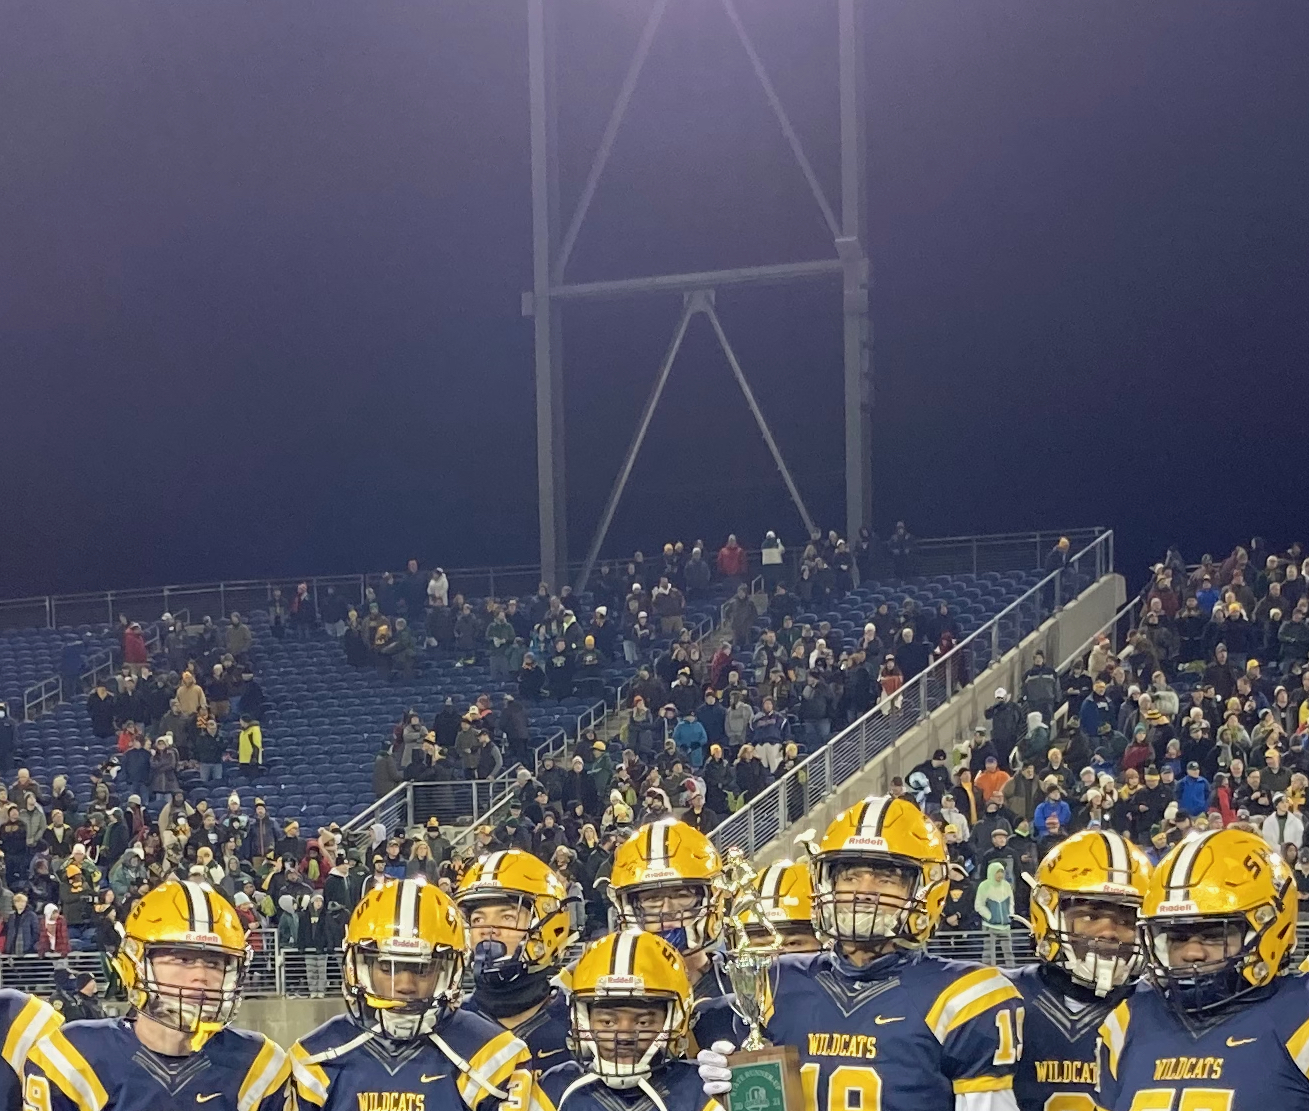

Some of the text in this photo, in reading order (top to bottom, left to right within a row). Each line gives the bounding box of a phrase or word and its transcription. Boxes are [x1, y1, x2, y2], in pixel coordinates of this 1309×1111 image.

[849, 837, 883, 846] Riddell
[1159, 905, 1192, 913] Riddell
[392, 939, 420, 949] Riddell
[607, 975, 634, 984] Riddell
[808, 1032, 877, 1059] WILDCATS
[1035, 1059, 1100, 1084] WILDCAT
[1153, 1056, 1223, 1081] WILDCATS
